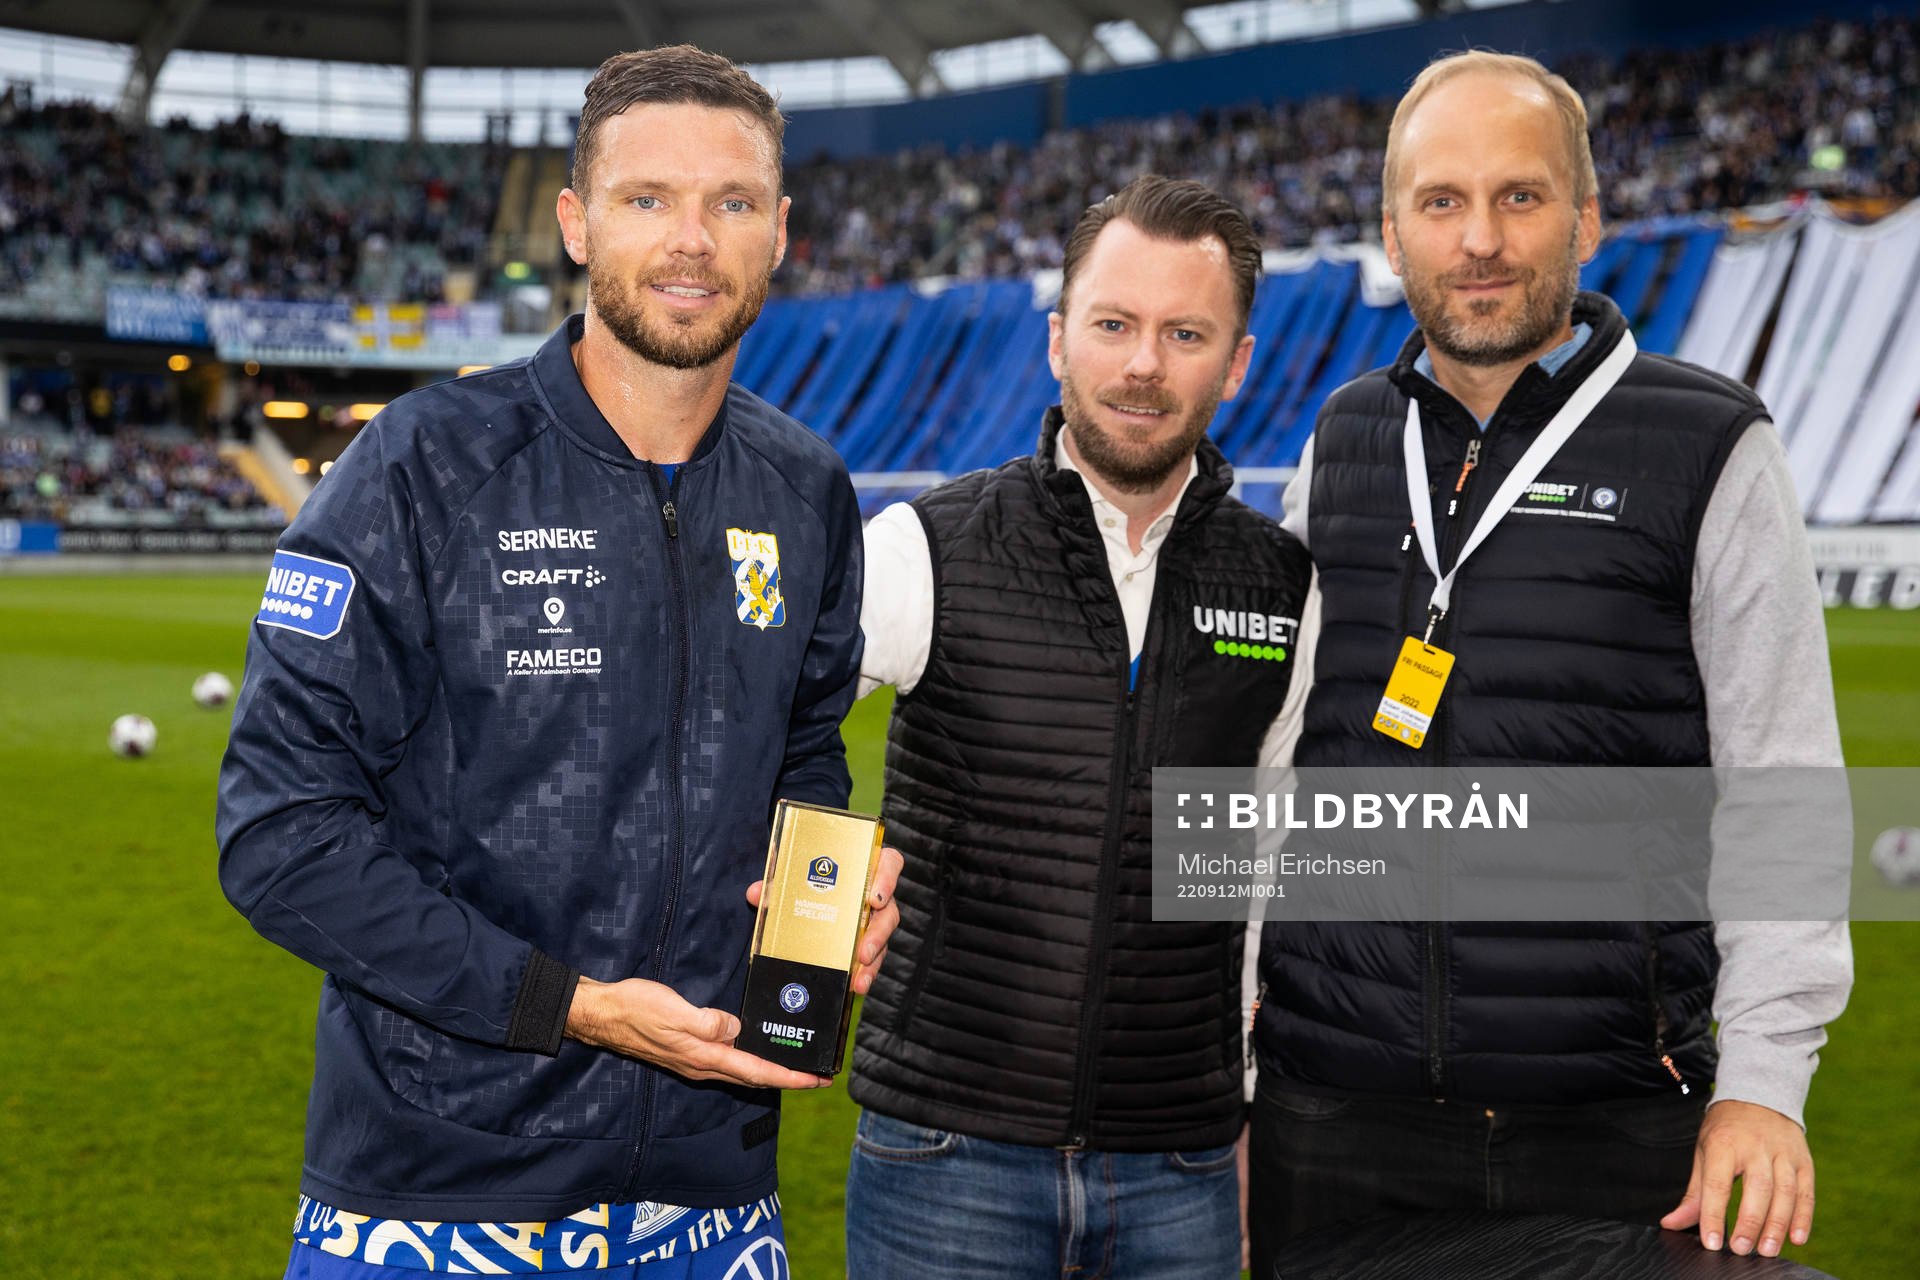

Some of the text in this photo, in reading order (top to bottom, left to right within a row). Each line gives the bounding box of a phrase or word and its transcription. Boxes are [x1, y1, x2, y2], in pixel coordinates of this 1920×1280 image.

[498, 528, 597, 551] SERNEKE
[502, 568, 584, 585] CRAFT
[1193, 605, 1299, 645] UNIBET
[507, 648, 602, 668] FAMECO
[572, 666, 602, 674] Company
[1399, 693, 1420, 709] 2022
[762, 1021, 815, 1042] UNIBET
[686, 1208, 733, 1253] IFK
